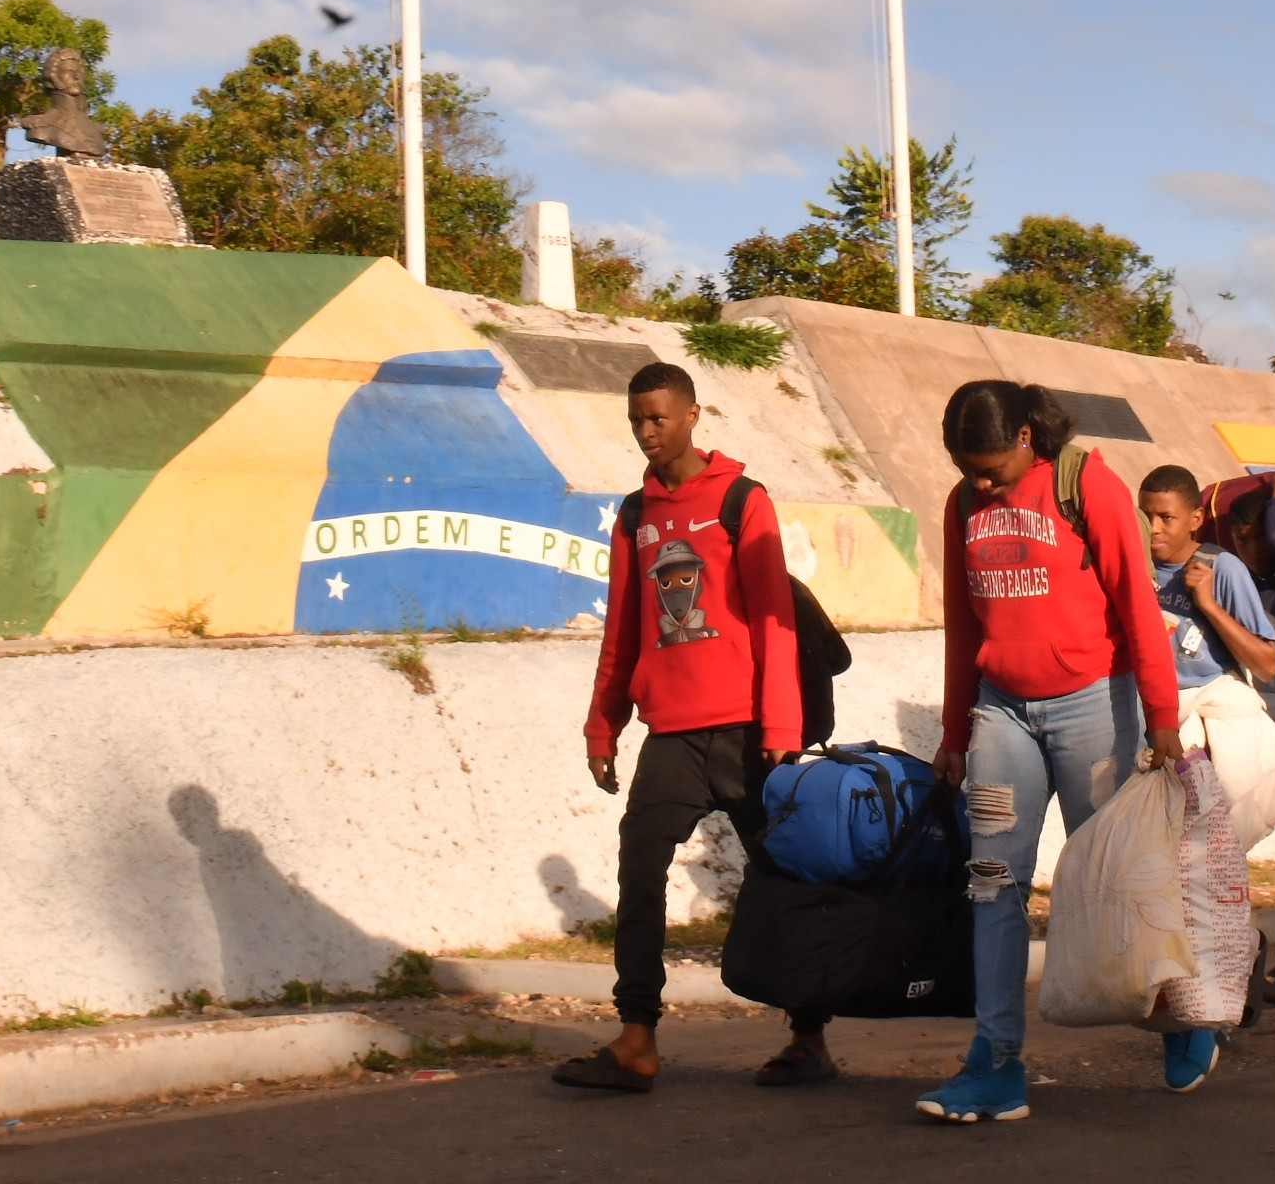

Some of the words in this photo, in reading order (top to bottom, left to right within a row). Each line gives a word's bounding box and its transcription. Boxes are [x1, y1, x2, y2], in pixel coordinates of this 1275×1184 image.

[315, 514, 469, 554] ORDEM
[499, 525, 512, 554] E
[1019, 508, 1058, 547] DUNBAR
[1005, 567, 1049, 598] EAGLES
